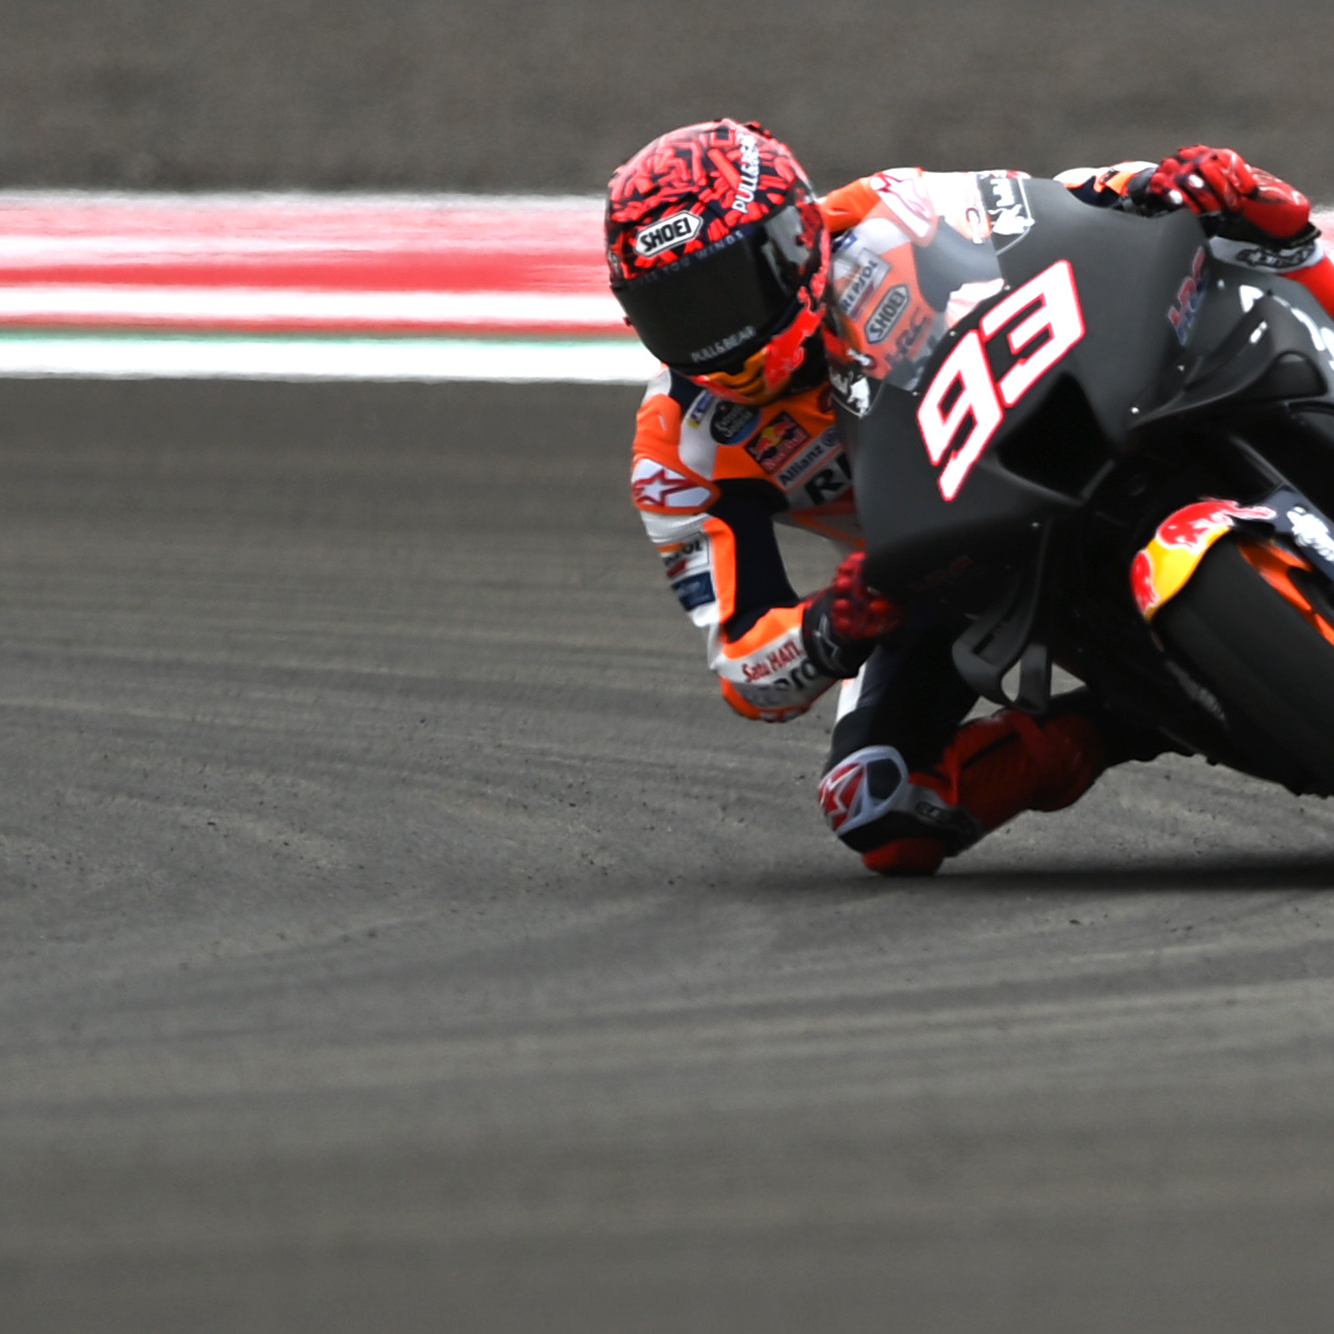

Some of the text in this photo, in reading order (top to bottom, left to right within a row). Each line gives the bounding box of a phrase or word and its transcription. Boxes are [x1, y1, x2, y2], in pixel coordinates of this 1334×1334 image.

[639, 216, 692, 252] SHOEI
[869, 290, 906, 338] SHOEI
[917, 259, 1086, 502] 93
[778, 445, 825, 486] Allianz
